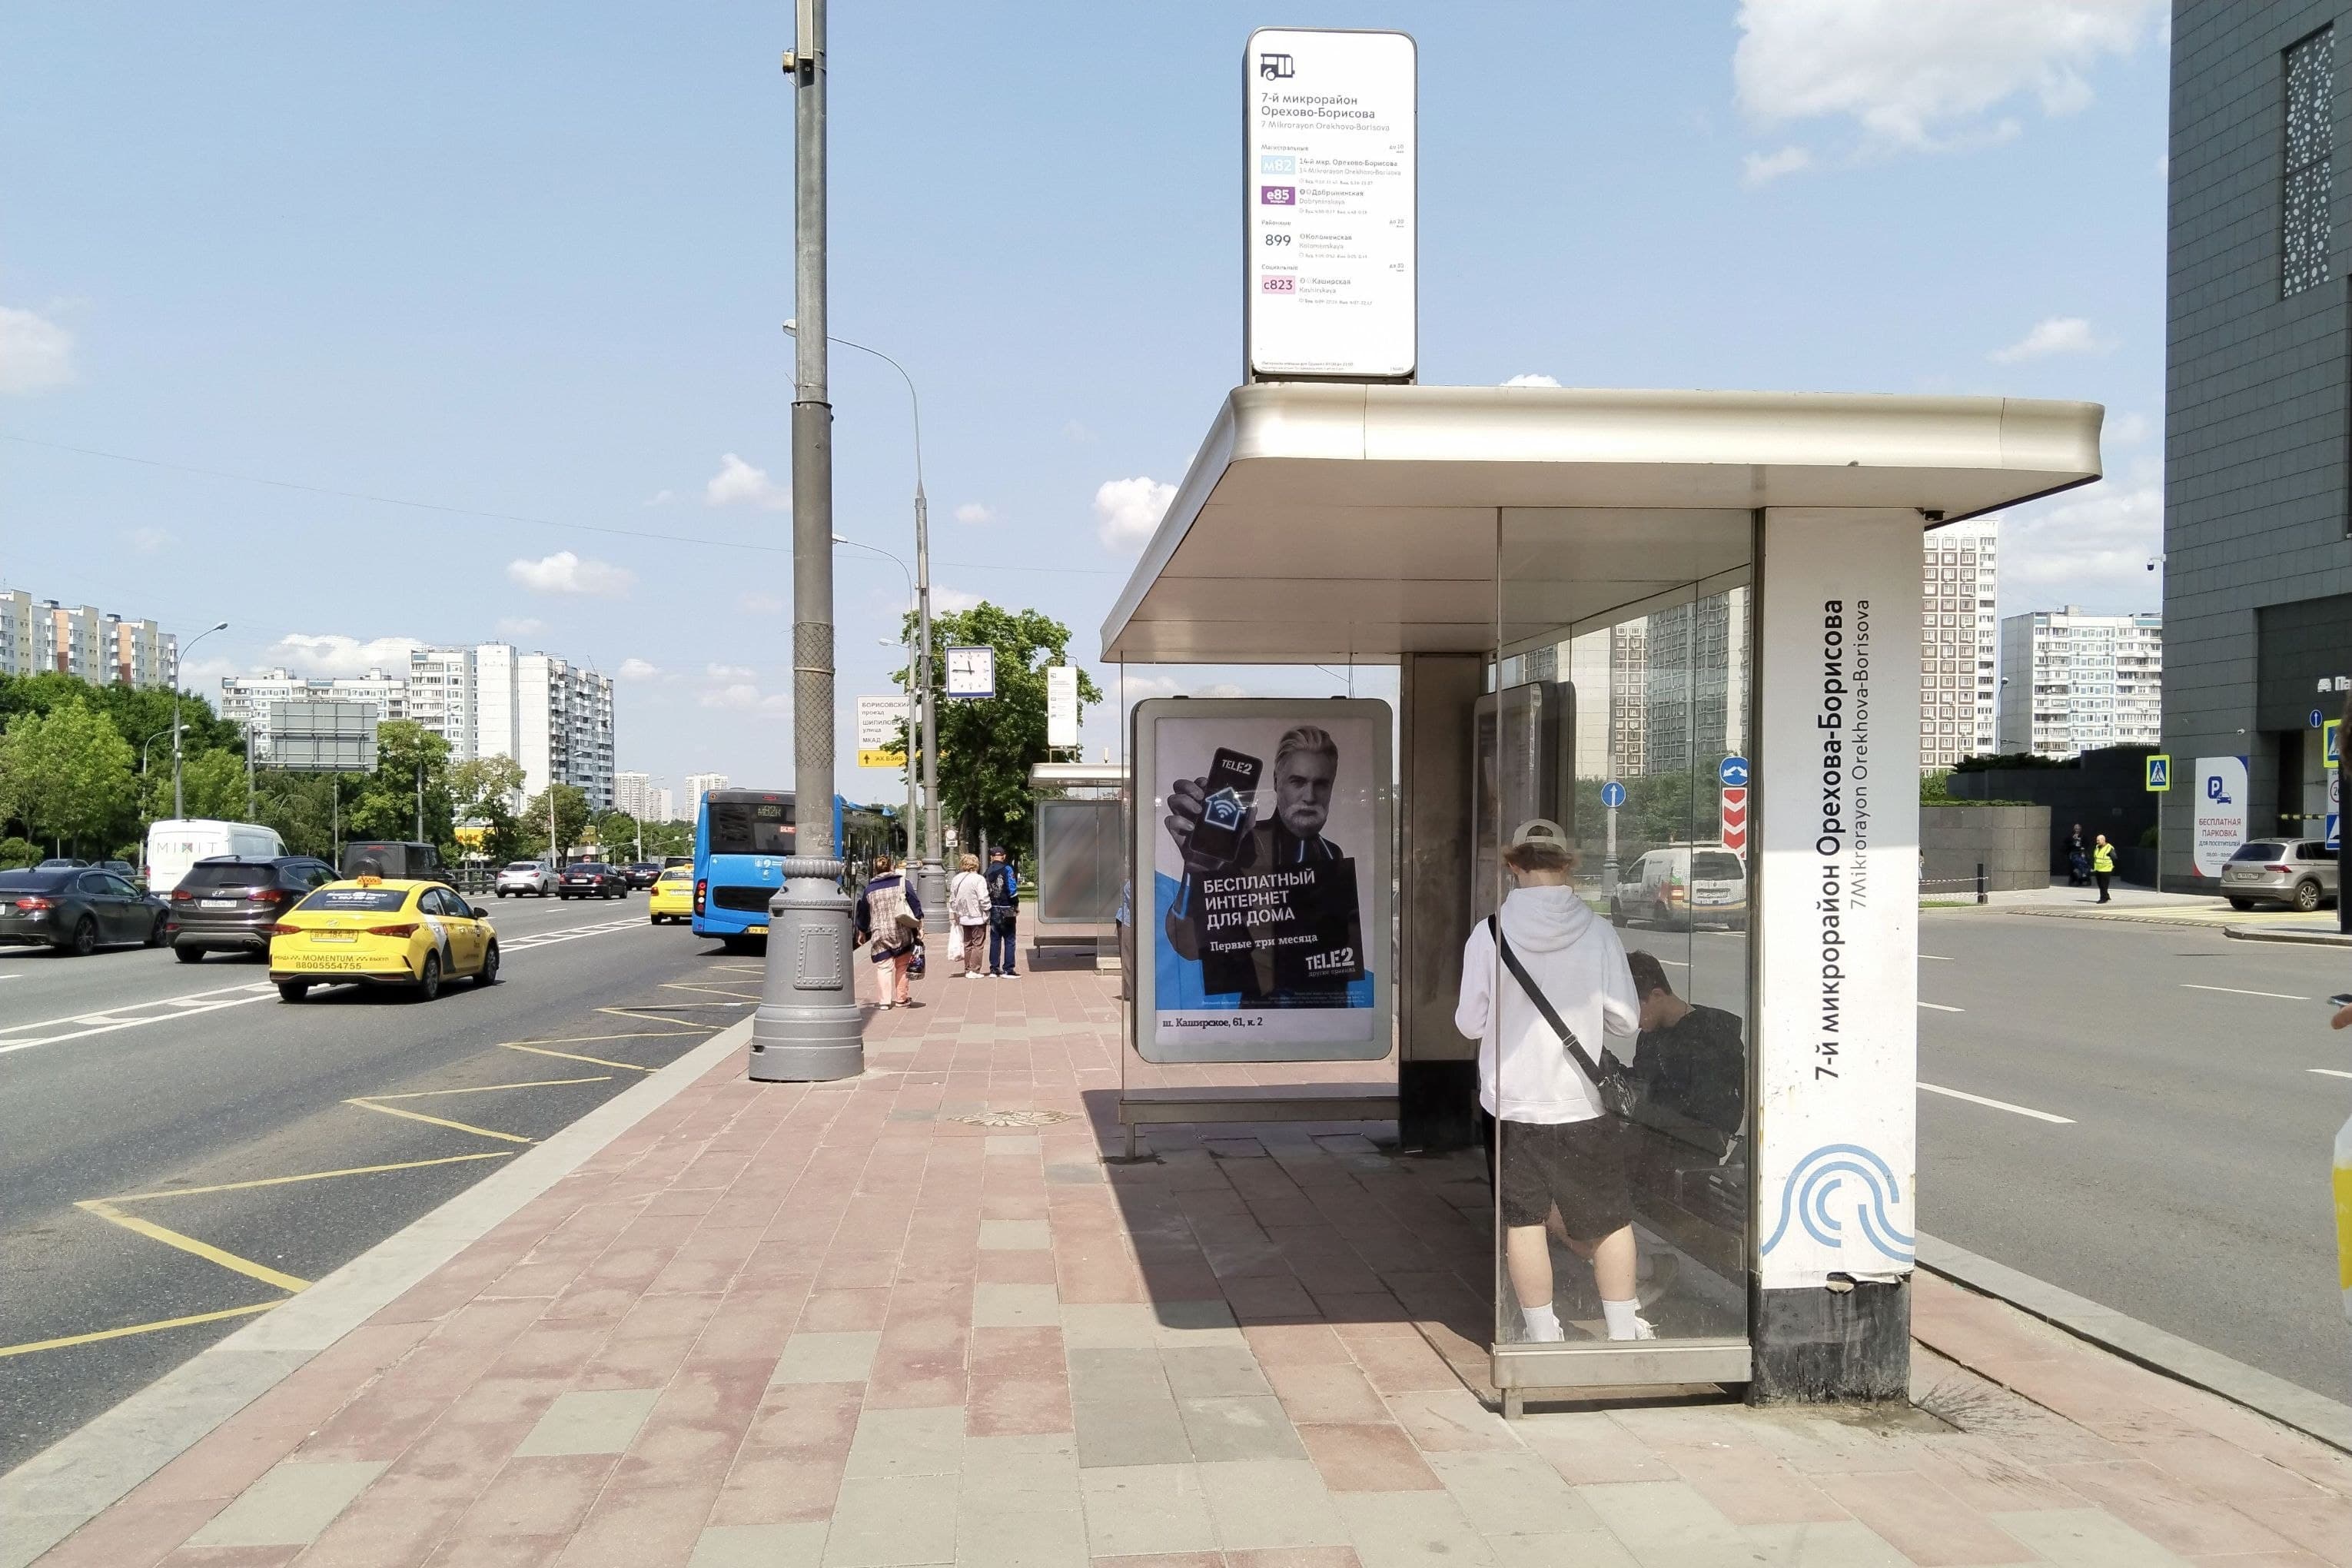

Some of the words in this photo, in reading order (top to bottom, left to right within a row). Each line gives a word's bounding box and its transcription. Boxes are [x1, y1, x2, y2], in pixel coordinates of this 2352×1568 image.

[1261, 93, 1279, 103] 7-й
[1282, 95, 1358, 106] микрорайон
[1261, 106, 1375, 119] Орехово-Борисова
[1268, 121, 1314, 130] Mikrorayon
[1264, 159, 1292, 171] м82
[1267, 189, 1290, 201] е85
[1265, 234, 1291, 247] 899
[1264, 280, 1293, 290] с823
[1852, 600, 1869, 780] Orekhova-Borisova
[1815, 600, 1848, 856] Орехова-Борисова
[1222, 759, 1253, 776] TELE2
[1204, 869, 1315, 894] БЕСПЛАТНЫЙ
[1205, 890, 1290, 911] ИНТЕРНЕТ
[1207, 912, 1242, 931] ДЛЯ
[1247, 907, 1296, 926] ДОМА
[1210, 940, 1252, 953] Первые
[1255, 938, 1276, 949] три
[1278, 934, 1318, 945] месяца
[1815, 865, 1845, 1033] микрорайон
[1305, 947, 1355, 971] TELE2
[1175, 1018, 1231, 1029] Каширское,
[1232, 1017, 1245, 1028] 61,
[1257, 1017, 1264, 1026] 2
[1815, 1041, 1839, 1081] 7-й
